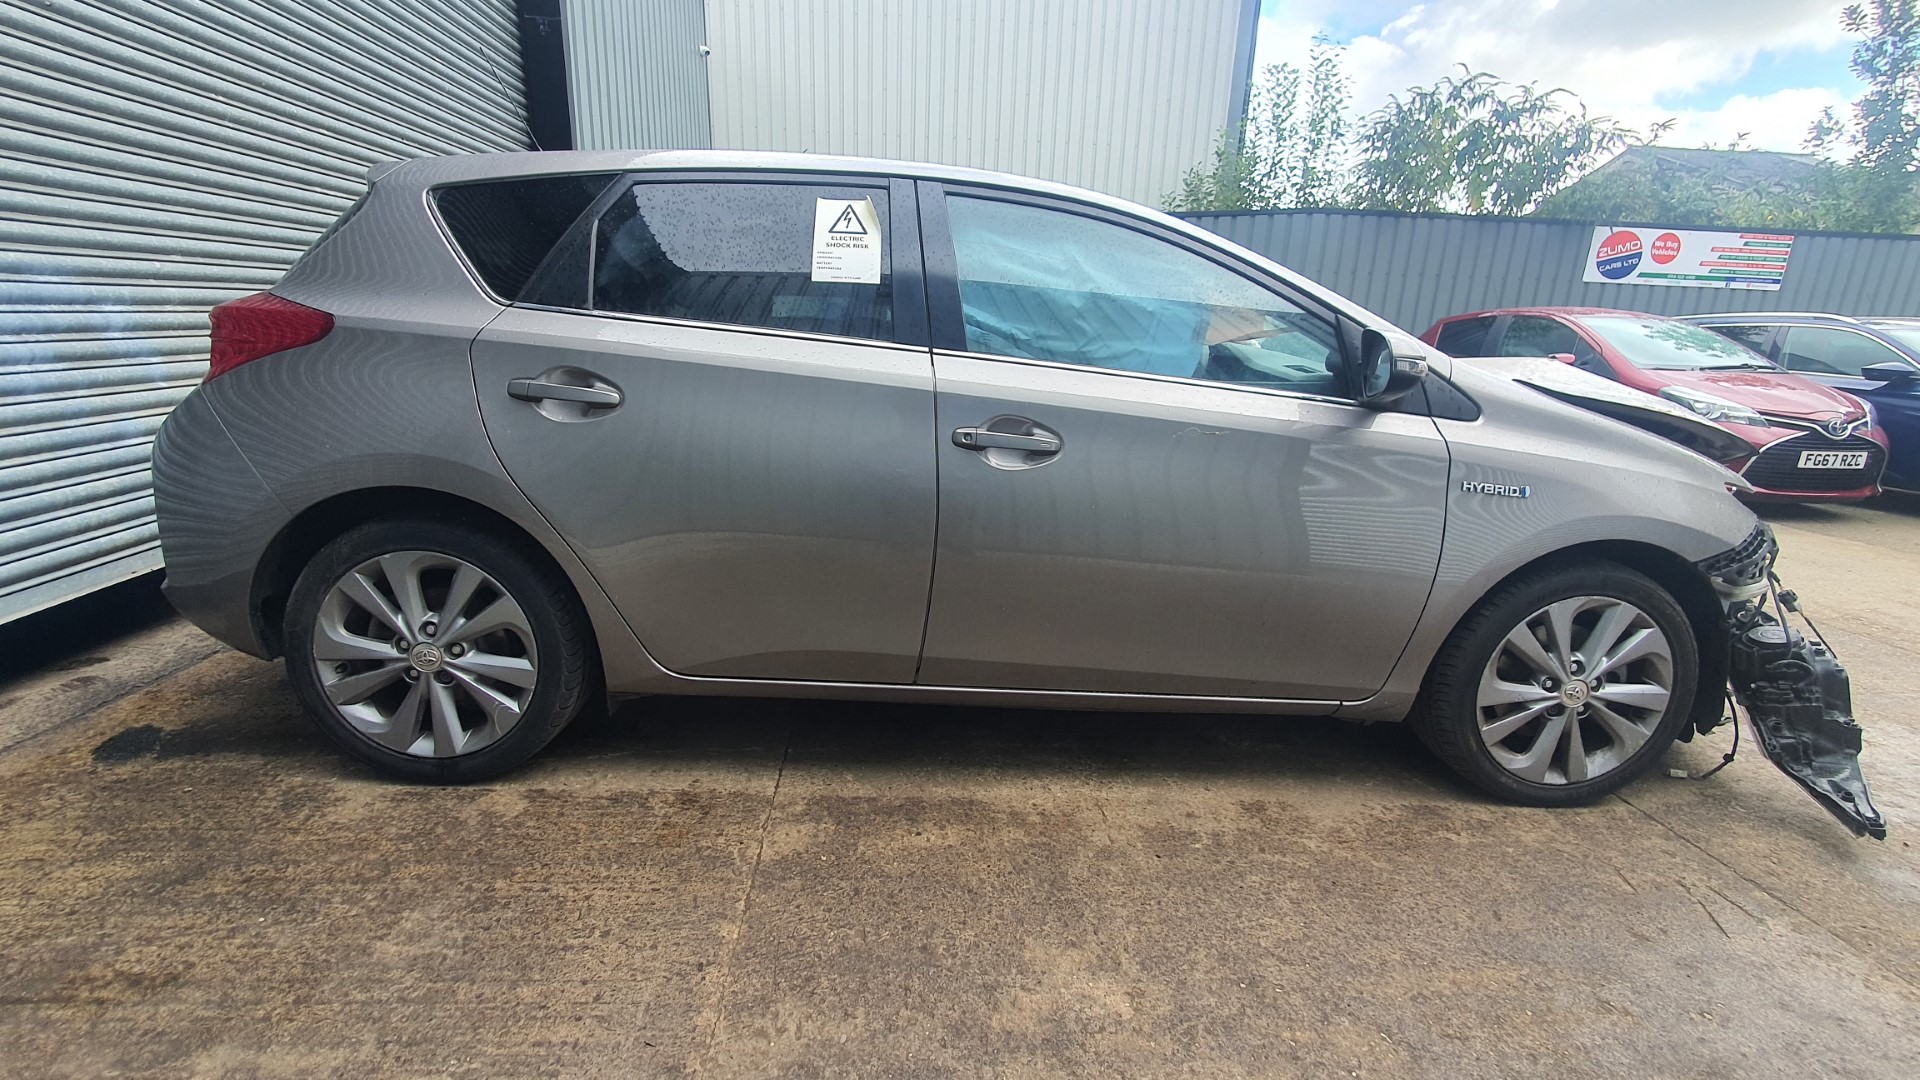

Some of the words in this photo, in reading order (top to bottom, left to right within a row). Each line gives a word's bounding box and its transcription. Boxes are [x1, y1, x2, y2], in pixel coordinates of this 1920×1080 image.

[1599, 240, 1641, 257] ZUMO
[1651, 248, 1678, 256] Vehicles
[1666, 241, 1679, 249] Buy
[1599, 261, 1622, 272] CARS
[1623, 258, 1639, 267] LTD
[1803, 453, 1839, 466] FG67
[1839, 454, 1863, 467] RZC
[1461, 480, 1520, 497] HYBRID
